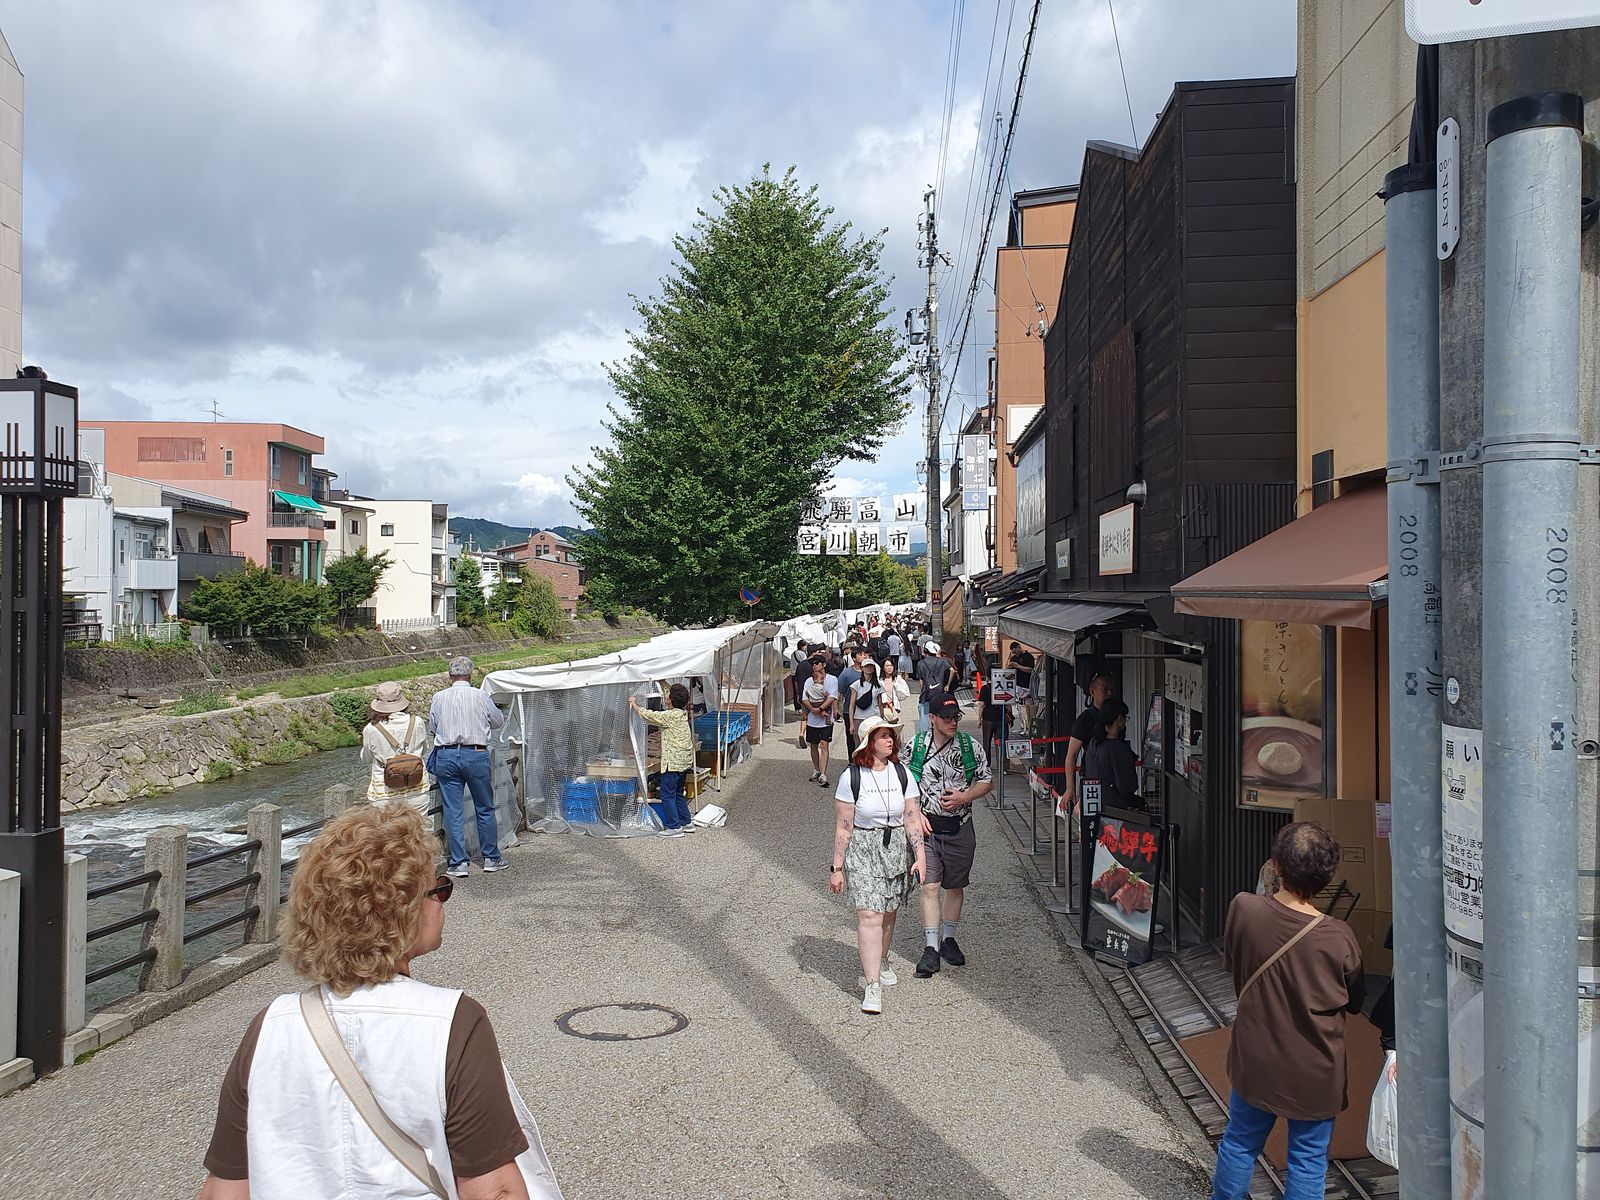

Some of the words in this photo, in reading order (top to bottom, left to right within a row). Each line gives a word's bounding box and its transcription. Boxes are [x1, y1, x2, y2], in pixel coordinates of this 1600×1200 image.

[801, 497, 916, 521] 飛騨高山
[799, 529, 908, 552] 宮川朝市
[1399, 514, 1419, 578] 2008
[1546, 527, 1569, 604] 2008
[1274, 621, 1292, 705] 栗きんとん
[994, 680, 1014, 690] 入口
[1086, 786, 1099, 814] 出口
[1098, 824, 1159, 864] 飛騨牛
